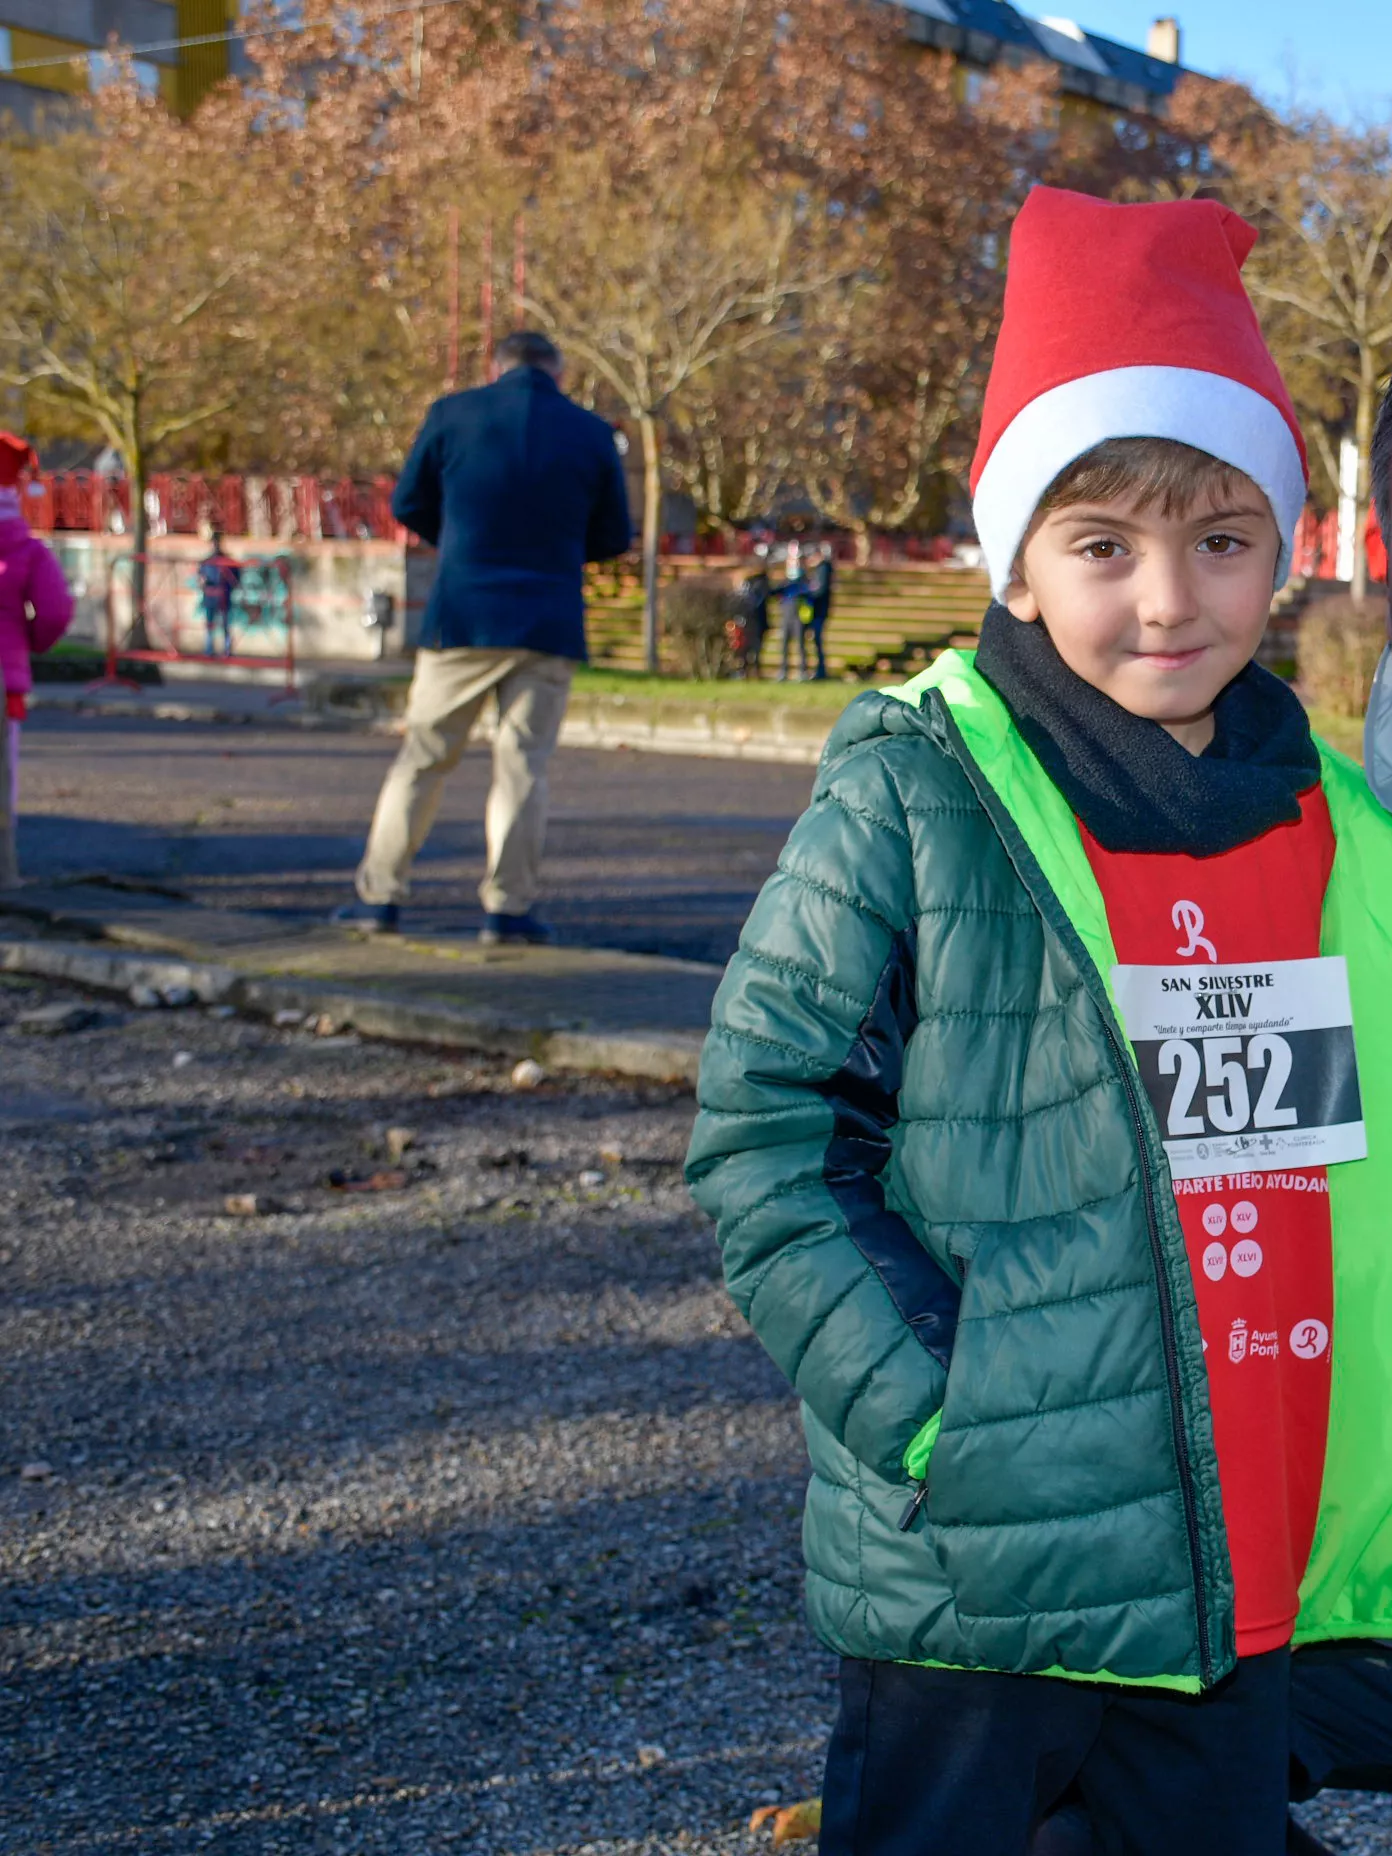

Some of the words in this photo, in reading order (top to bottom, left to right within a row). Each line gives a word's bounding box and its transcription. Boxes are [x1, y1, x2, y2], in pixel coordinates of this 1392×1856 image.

[1161, 977, 1191, 992] SAN
[1198, 973, 1275, 991] SILVESTRE
[1196, 993, 1253, 1020] XLIV
[1186, 1022, 1224, 1035] comparte
[1225, 1020, 1247, 1032] tiempo
[1158, 1033, 1298, 1136] 252
[1207, 1215, 1224, 1225] XLIV
[1236, 1212, 1252, 1222] XLV
[1236, 1252, 1257, 1263] XLVI
